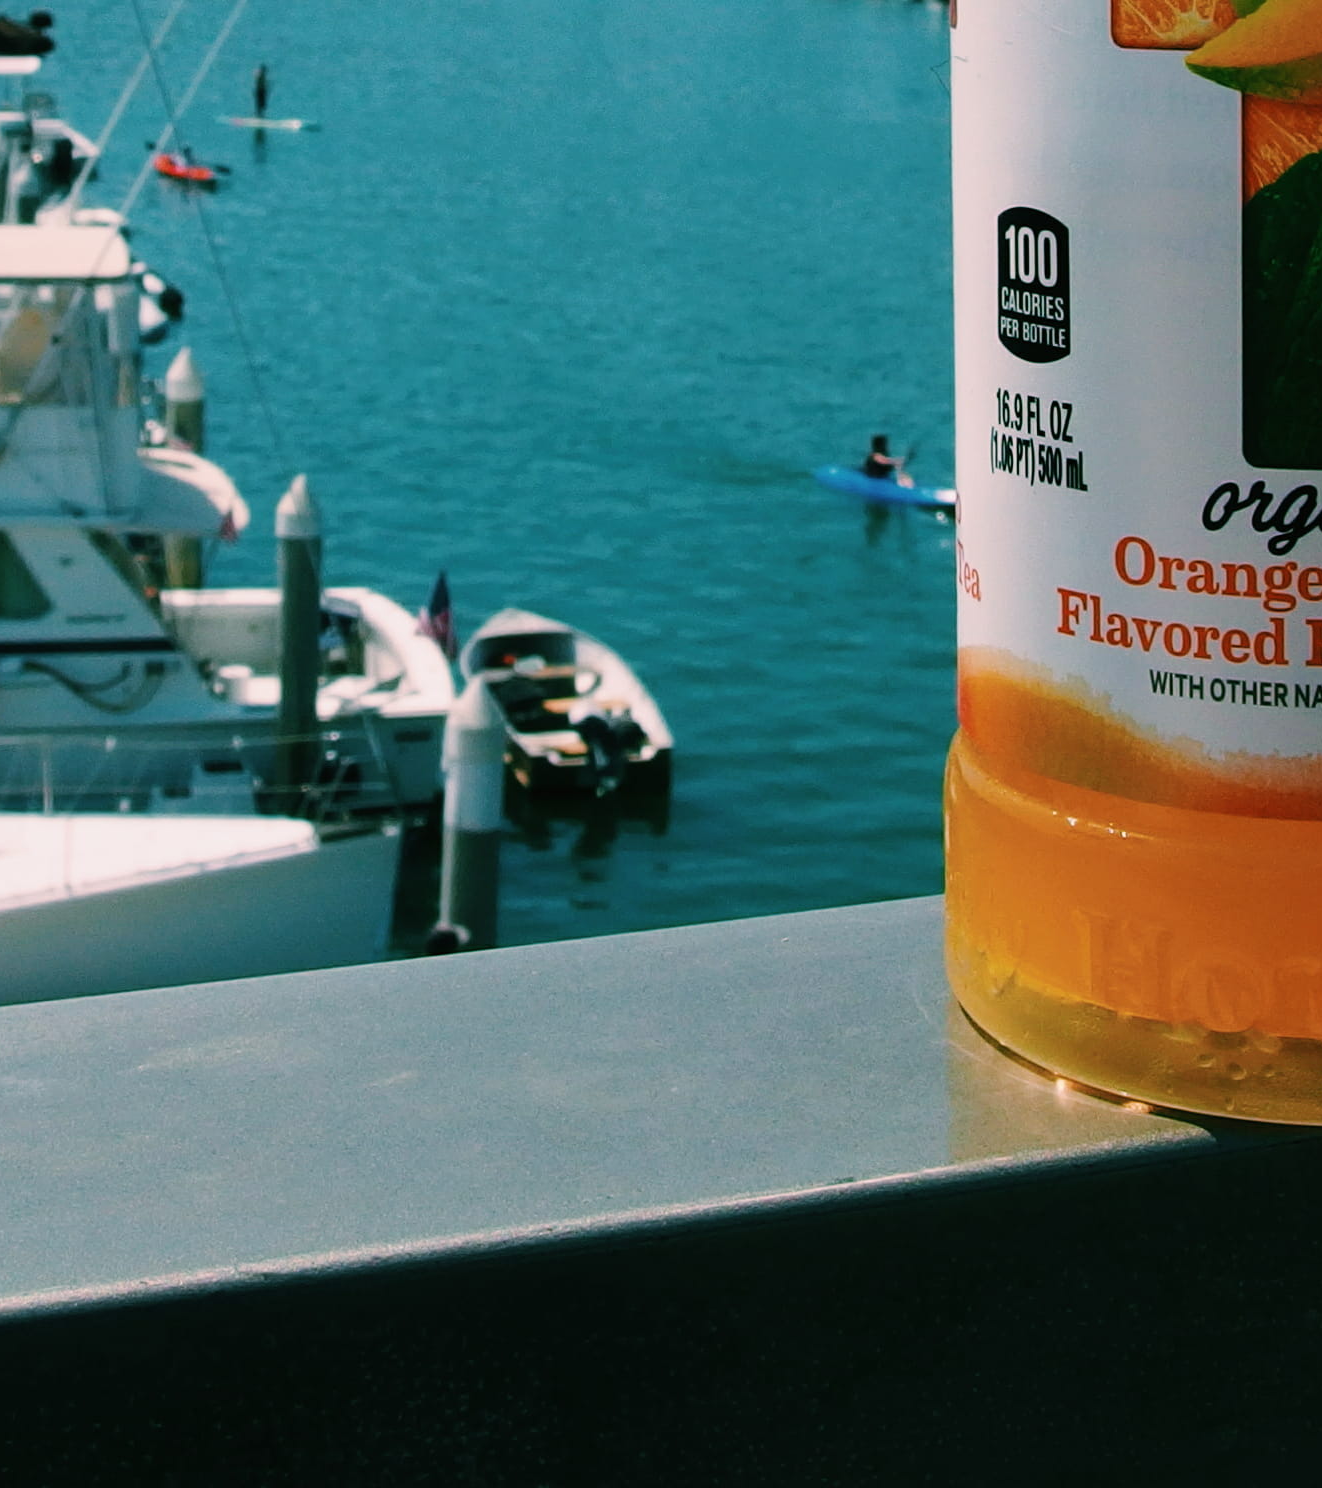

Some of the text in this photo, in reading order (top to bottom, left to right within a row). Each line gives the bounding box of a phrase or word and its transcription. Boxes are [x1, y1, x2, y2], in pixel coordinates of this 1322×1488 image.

[1005, 224, 1058, 288] 100
[1000, 316, 1067, 349] PER BOTTLE
[1001, 286, 1065, 322] CALORIES
[997, 387, 1074, 444] 16.9 FL OZ
[990, 426, 1089, 492] (1.06 PT) 500 mL
[1056, 587, 1290, 666] Flavored
[1149, 669, 1204, 701] WITH
[1210, 677, 1289, 708] OTHER
